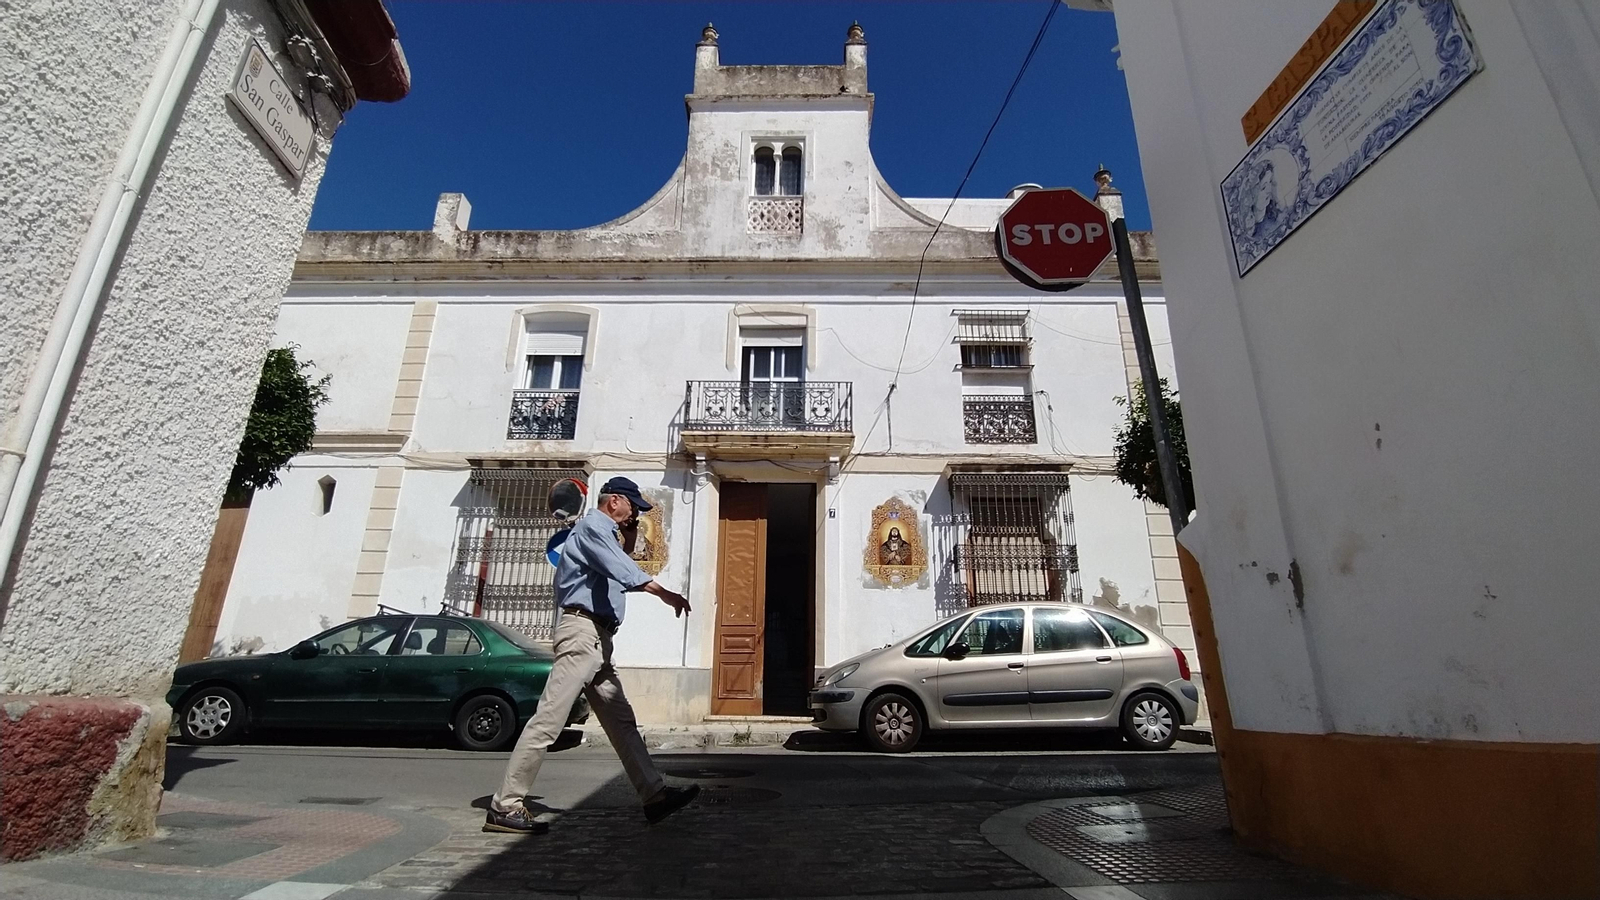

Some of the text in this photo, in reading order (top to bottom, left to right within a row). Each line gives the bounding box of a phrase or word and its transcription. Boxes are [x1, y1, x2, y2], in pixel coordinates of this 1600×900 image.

[269, 79, 294, 114] Calle
[240, 74, 304, 160] San Gaspar
[1011, 222, 1104, 246] STOP
